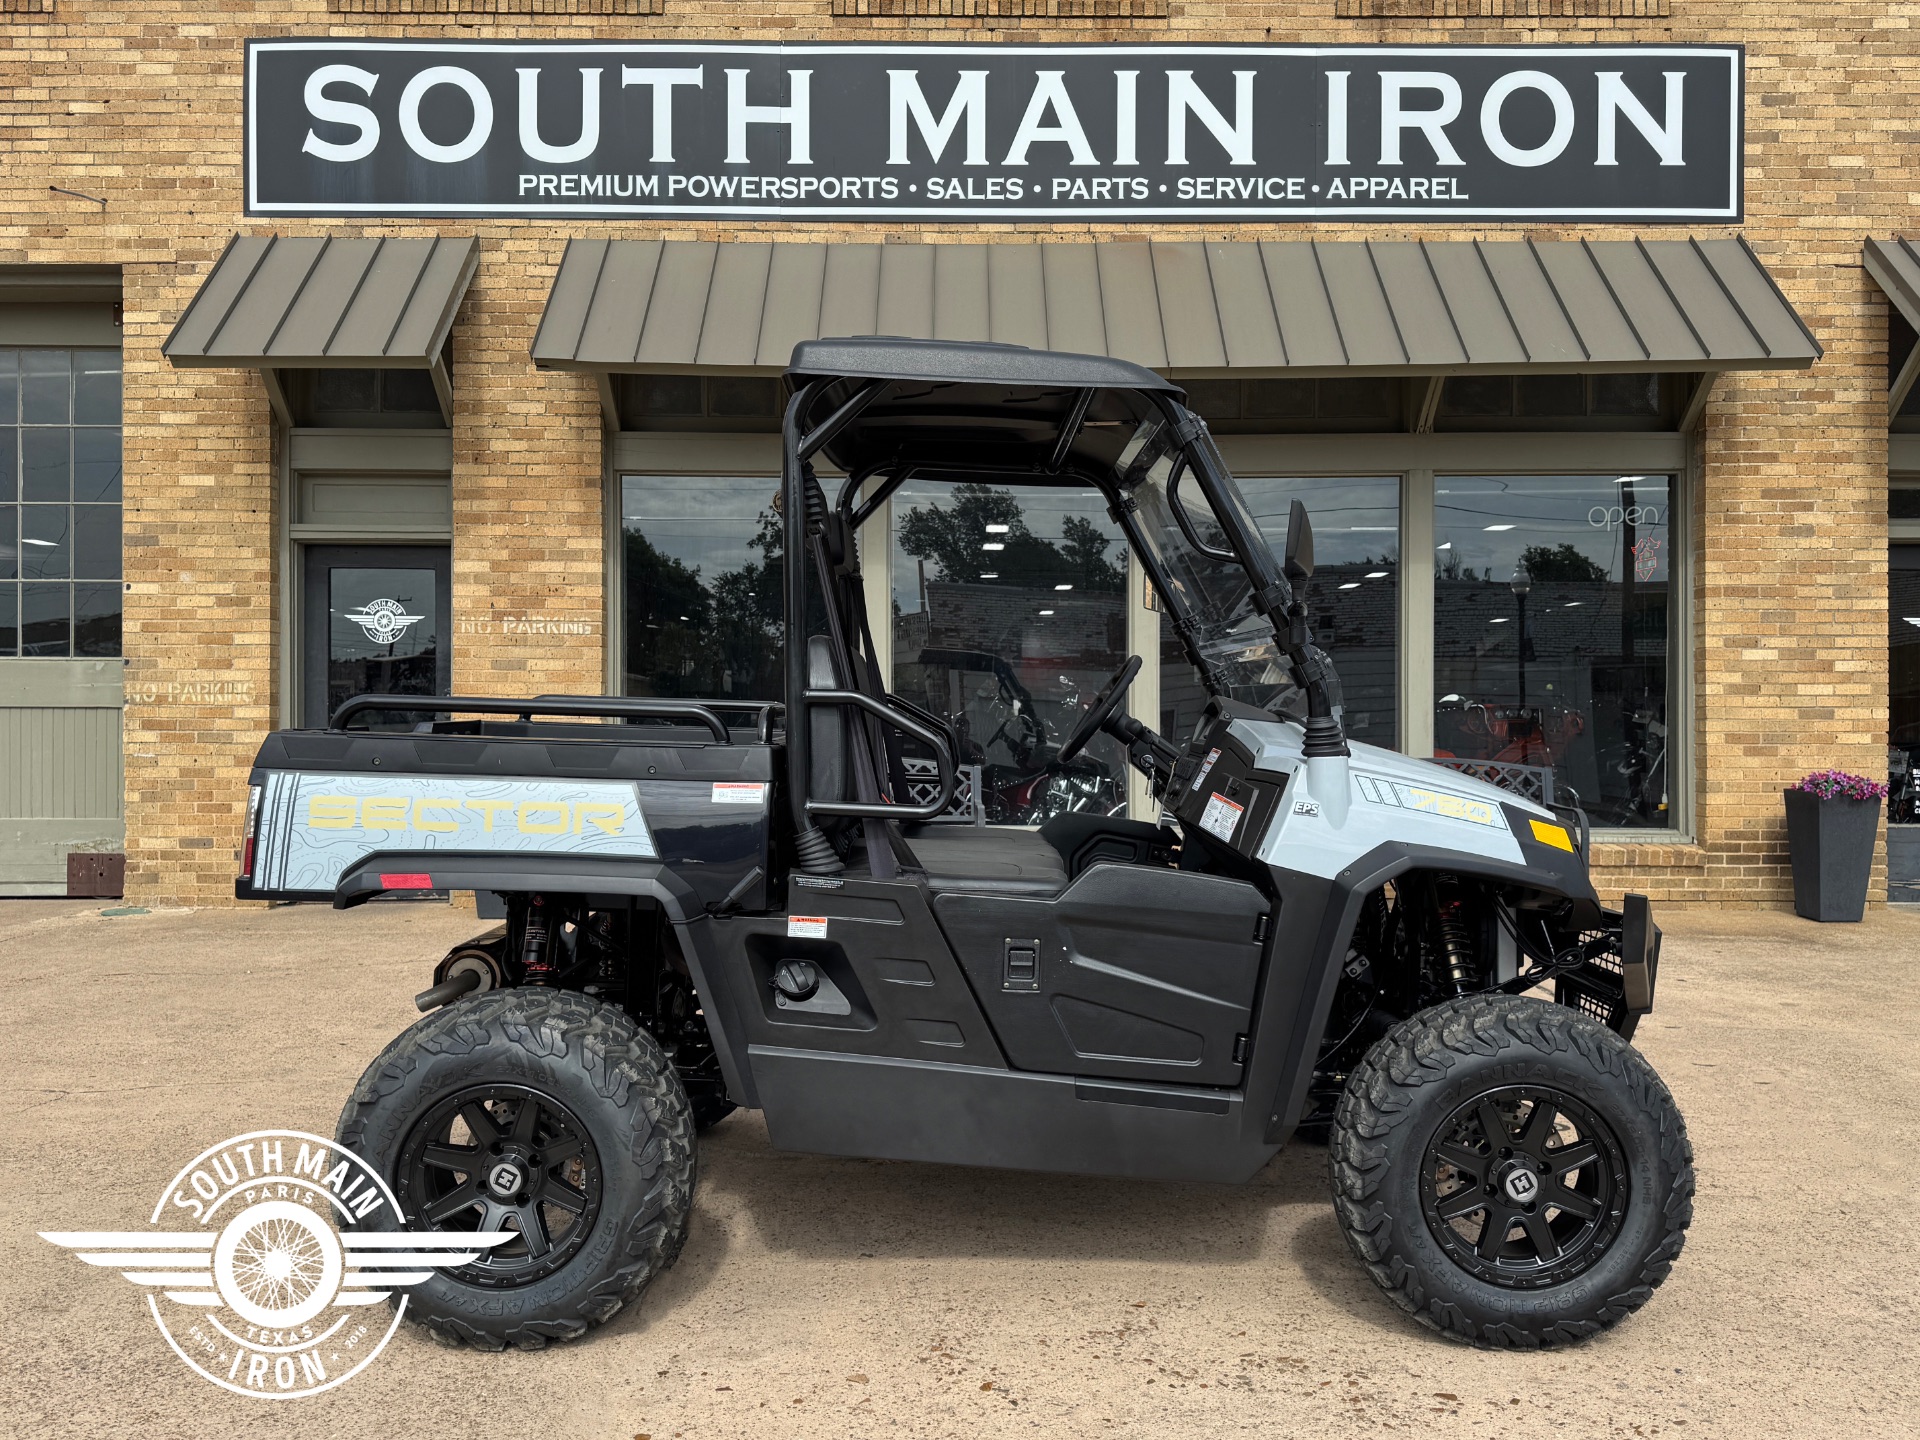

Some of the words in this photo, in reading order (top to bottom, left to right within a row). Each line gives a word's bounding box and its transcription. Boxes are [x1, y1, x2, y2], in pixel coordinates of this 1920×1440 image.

[302, 63, 814, 165] SOUTH
[886, 69, 1257, 166] MAIN
[1324, 69, 1687, 167] IRON
[518, 174, 659, 197] PREMIUM
[667, 174, 898, 200] POWERSPORTS
[927, 177, 1024, 200] SALES
[1051, 177, 1149, 200] PARTS
[1176, 177, 1306, 200] SERVICE
[1326, 177, 1469, 200] APPAREL
[1588, 506, 1658, 532] open
[461, 616, 492, 634] NO
[503, 616, 592, 635] PARKING
[125, 682, 158, 703] NO
[167, 682, 256, 703] PARKING
[308, 795, 625, 836] SECTOR
[1294, 801, 1319, 815] EPS
[1410, 788, 1491, 824] 750
